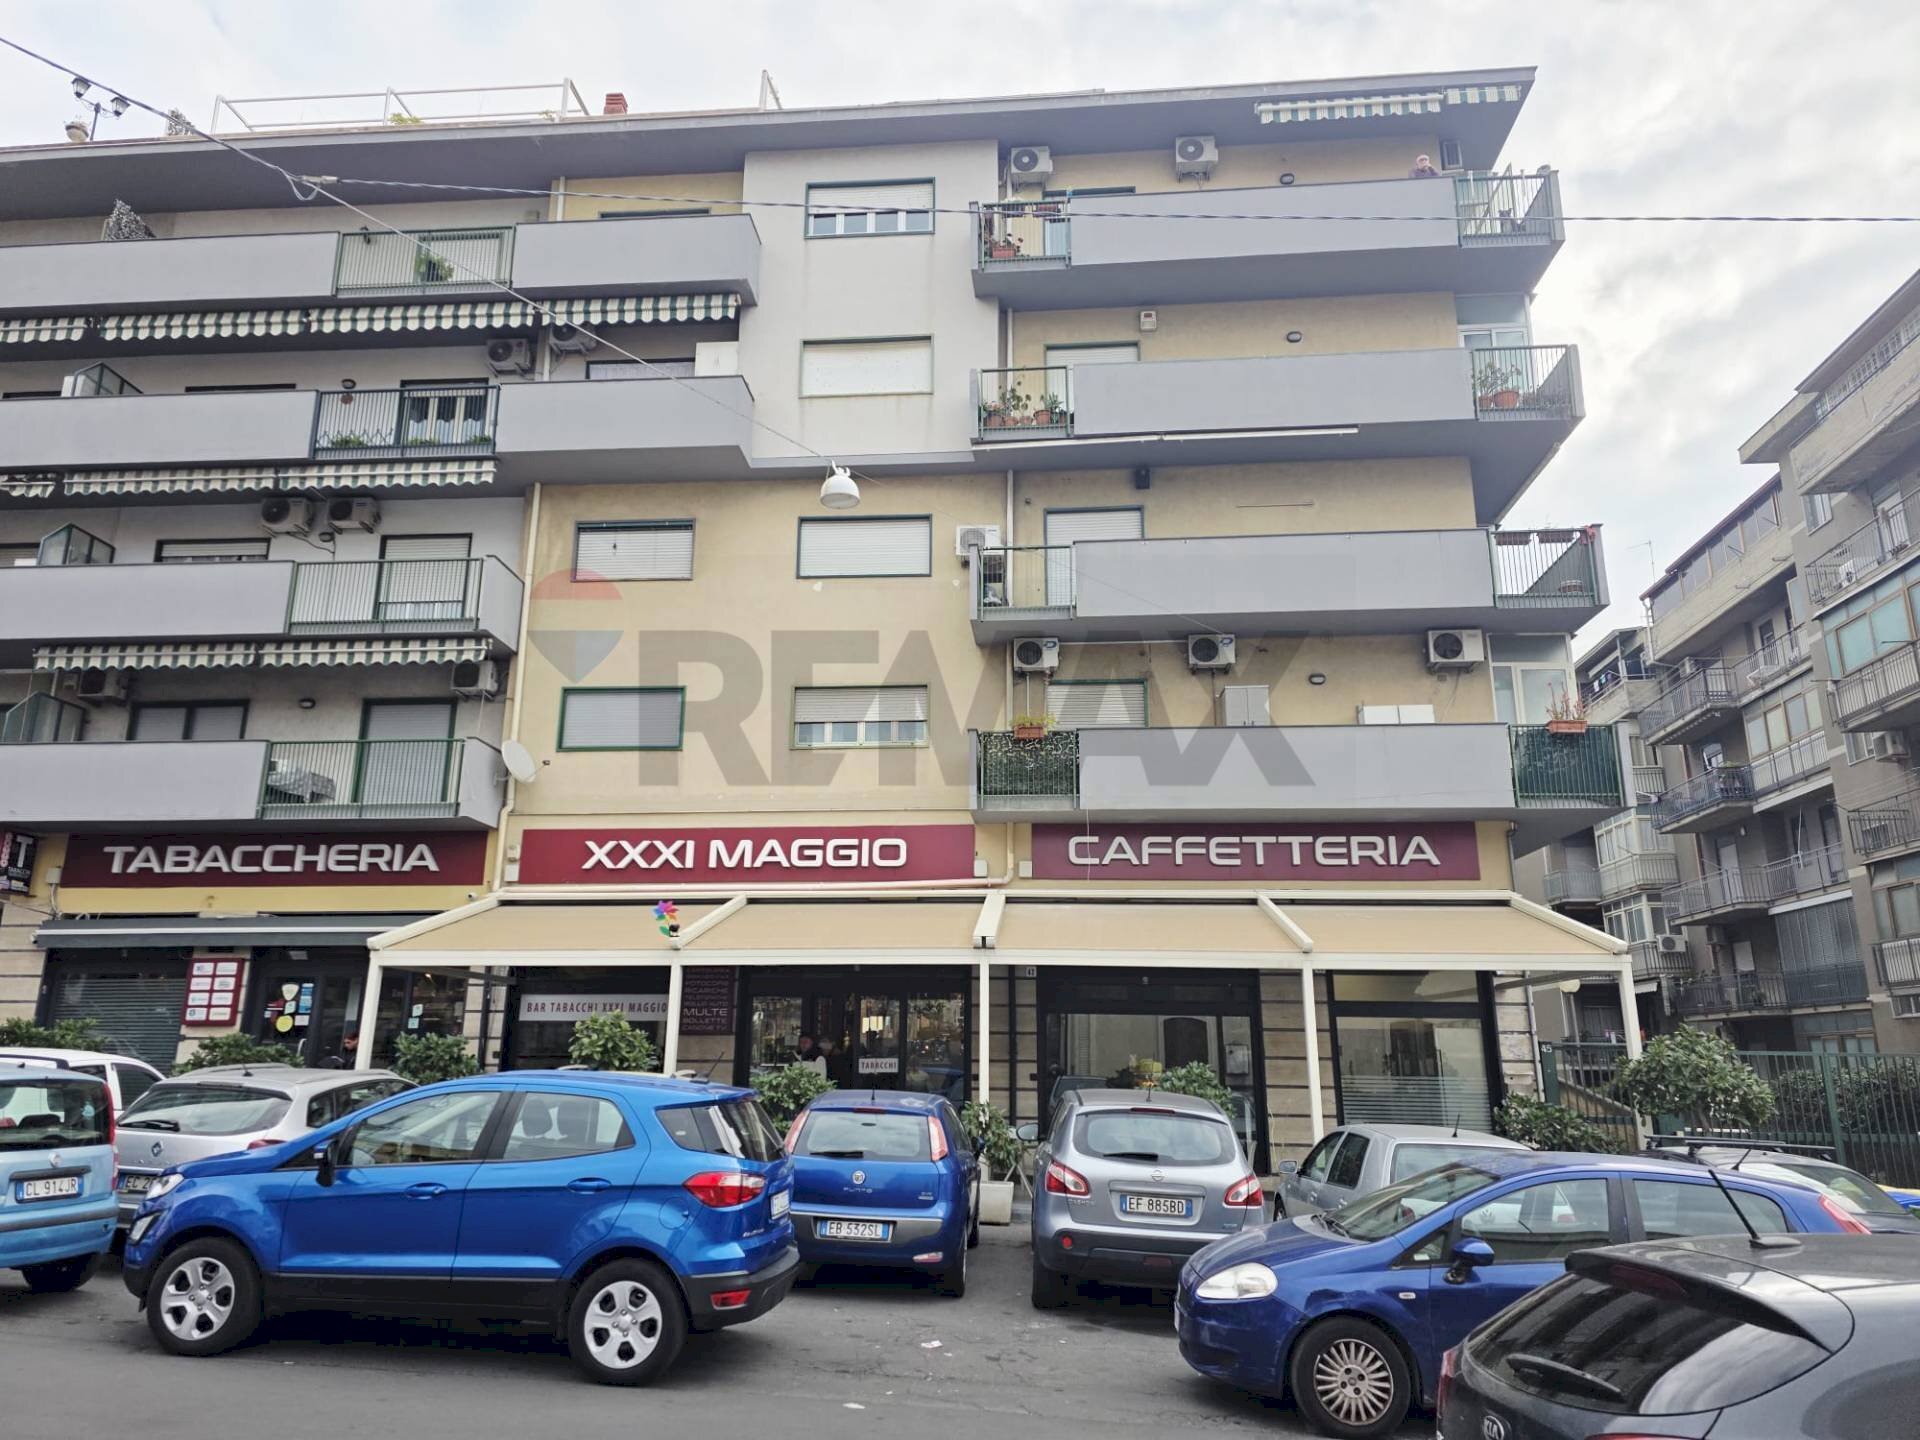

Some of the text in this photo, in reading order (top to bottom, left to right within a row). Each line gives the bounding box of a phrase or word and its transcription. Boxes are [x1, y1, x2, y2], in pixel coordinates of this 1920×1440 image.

[16, 834, 34, 868] T
[104, 843, 440, 874] TABACCHERIA
[582, 838, 907, 869] XXXI MAGGIO
[1068, 835, 1441, 866] CAFFETTERIA
[527, 1002, 667, 1013] BAR TABACCHI XXXI MAGGIO
[683, 1007, 728, 1016] MULTE
[1541, 1044, 1552, 1052] 45
[25, 1177, 77, 1197] CL 914JR
[126, 1175, 140, 1188] EC
[1128, 1197, 1184, 1214] EF 885BD
[829, 1221, 881, 1237] EB 532SL
